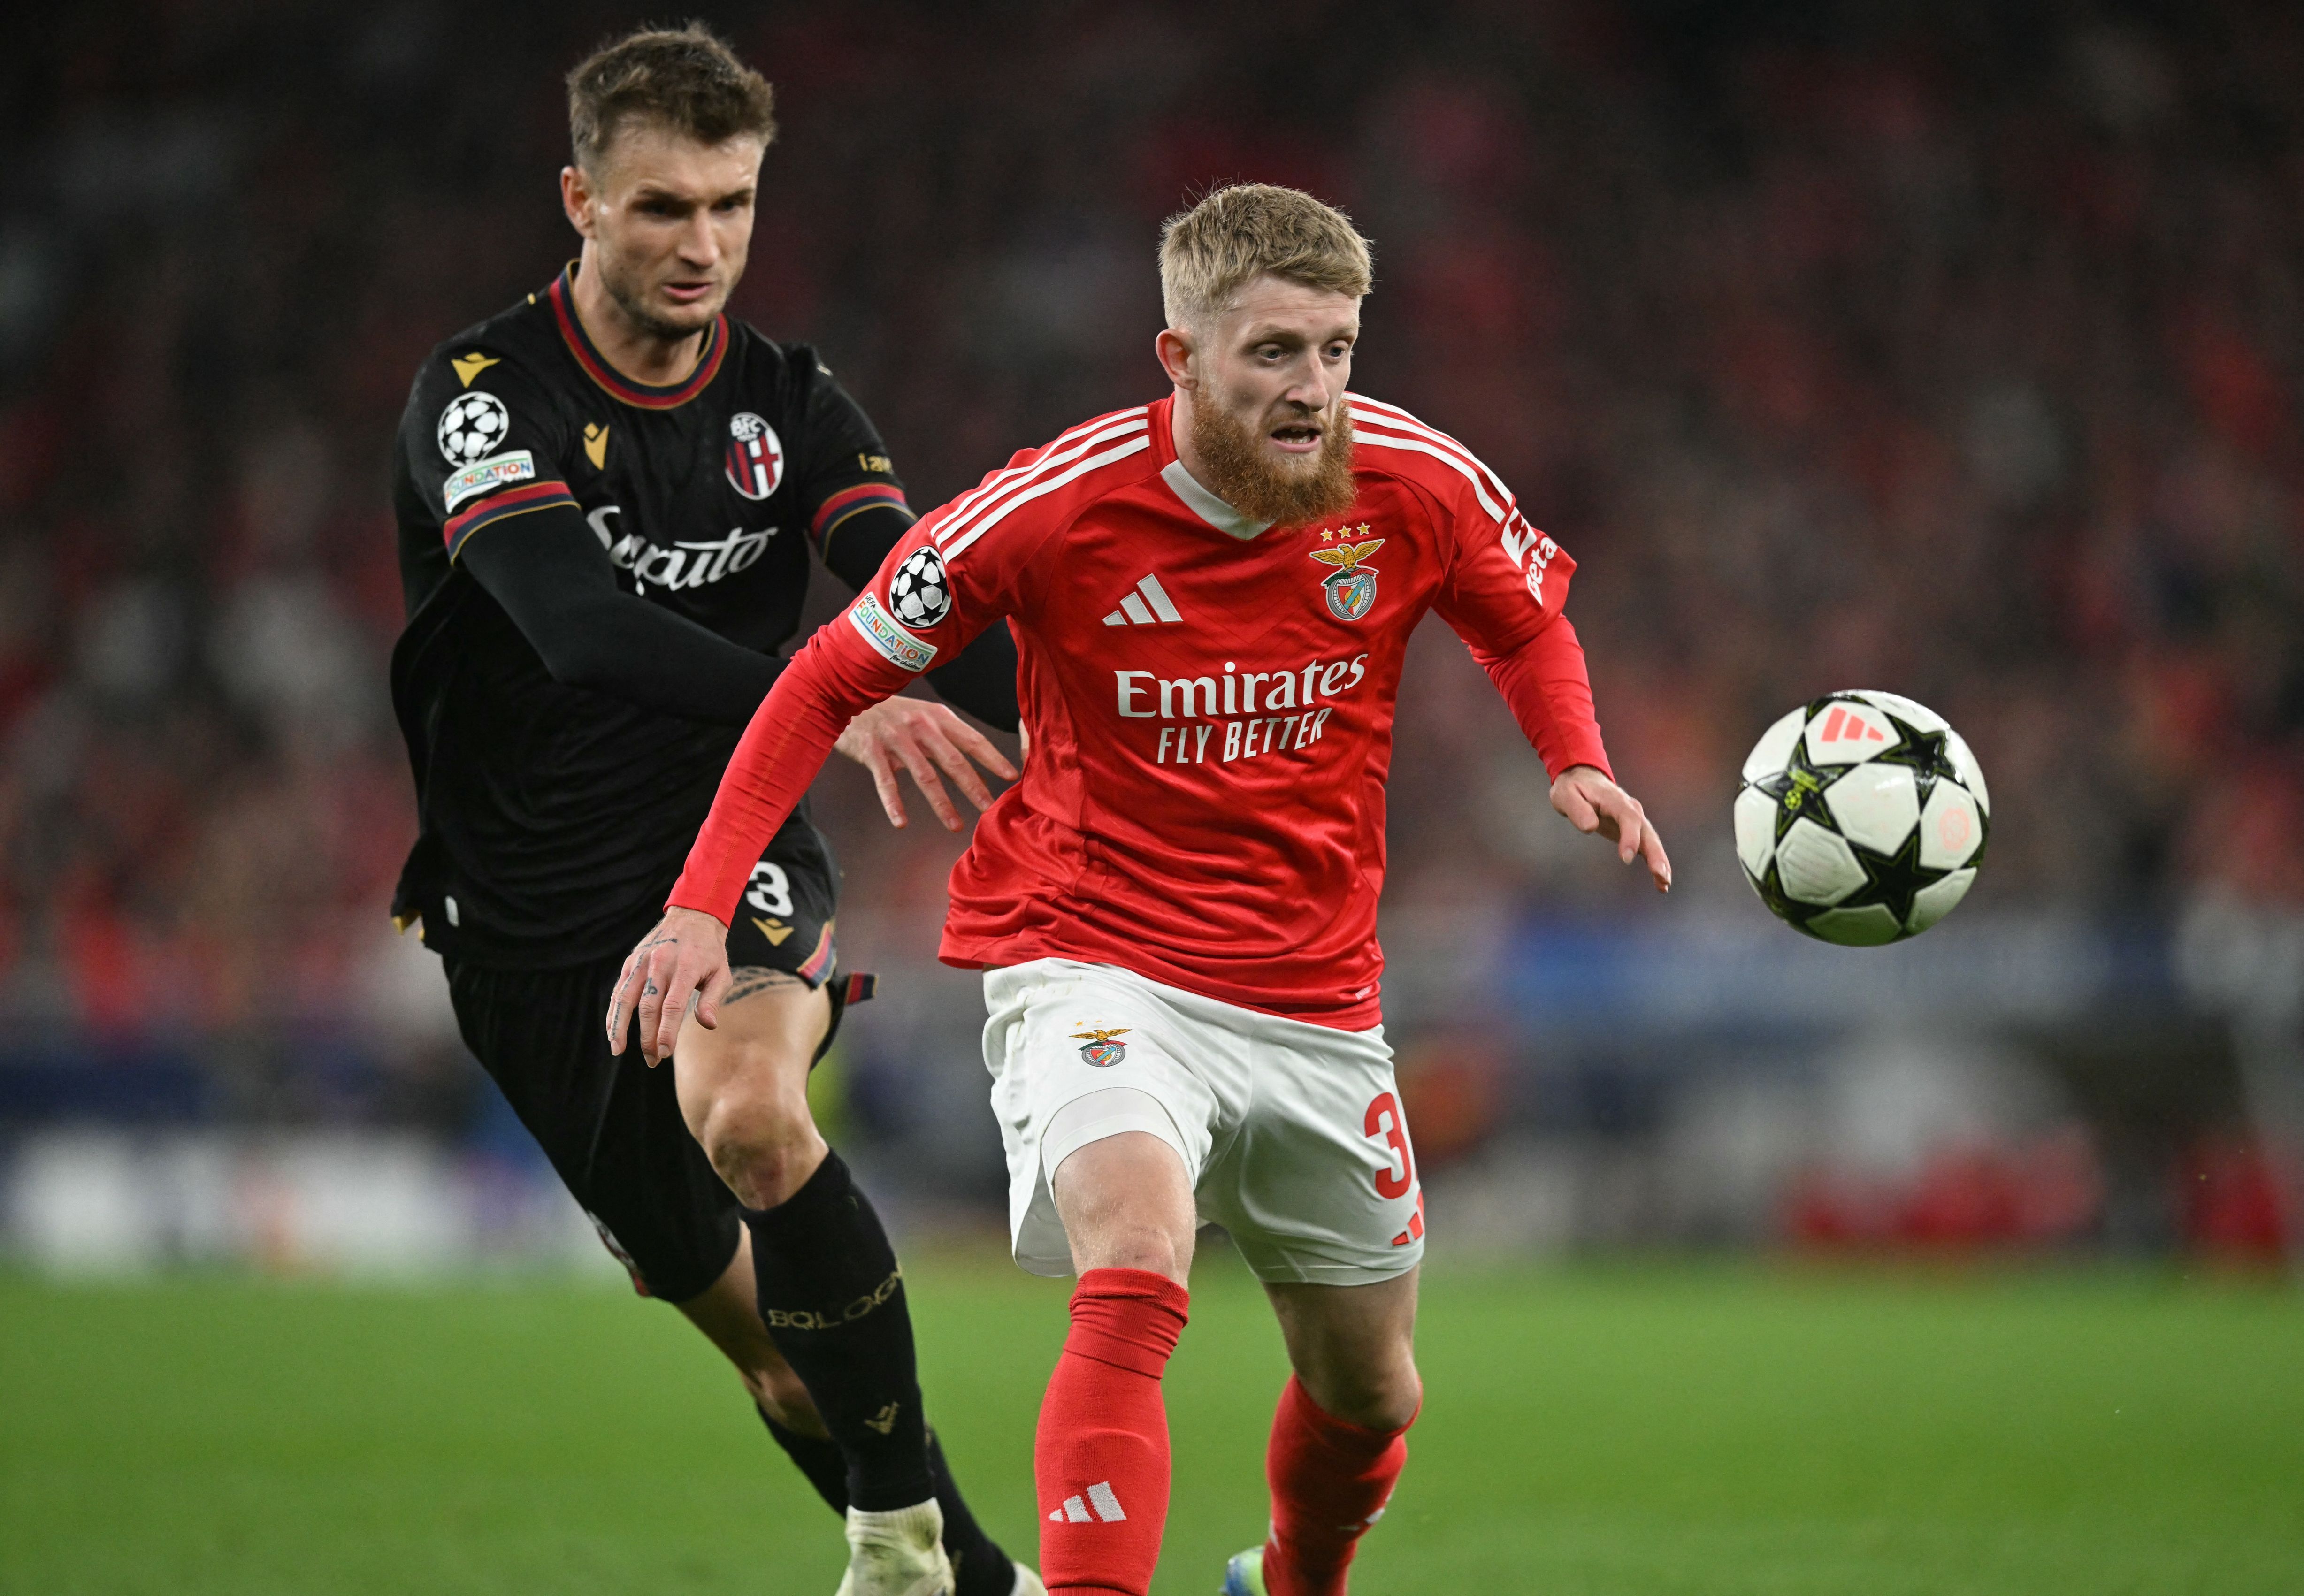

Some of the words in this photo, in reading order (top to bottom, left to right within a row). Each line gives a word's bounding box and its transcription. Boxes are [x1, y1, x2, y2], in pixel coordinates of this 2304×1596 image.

[865, 594, 876, 610] UEFA
[857, 600, 930, 664] FOUNDATION
[900, 660, 921, 670] children
[1114, 653, 1369, 718] Emirates
[1157, 725, 1213, 764] FLY
[1223, 707, 1333, 763] BETTER
